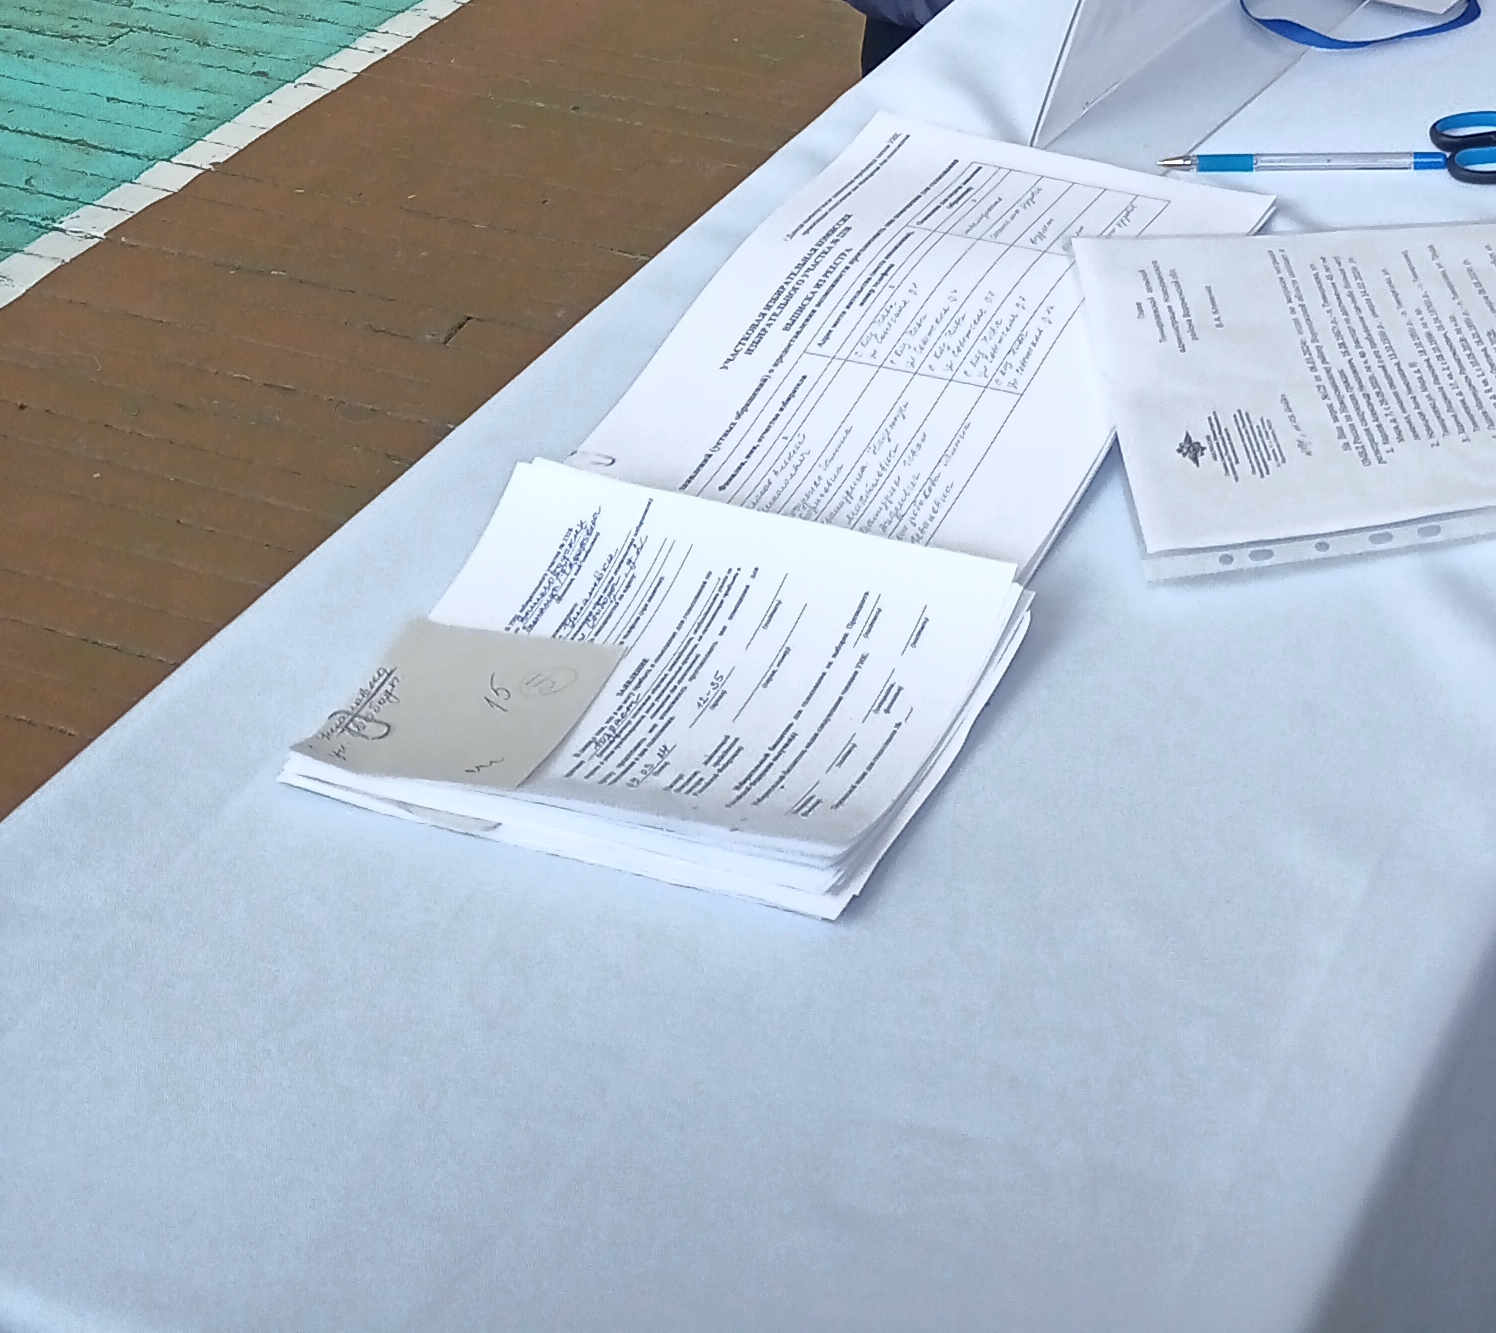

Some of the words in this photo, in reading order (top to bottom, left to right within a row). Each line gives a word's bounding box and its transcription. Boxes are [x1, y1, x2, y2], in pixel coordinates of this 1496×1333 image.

[719, 307, 764, 371] УЧАСТКОВАЯ
[763, 246, 819, 317] ИЗБИРАТЕЛЬНАЯ
[782, 288, 818, 332] ВЫПИСКА
[483, 671, 512, 712] 15
